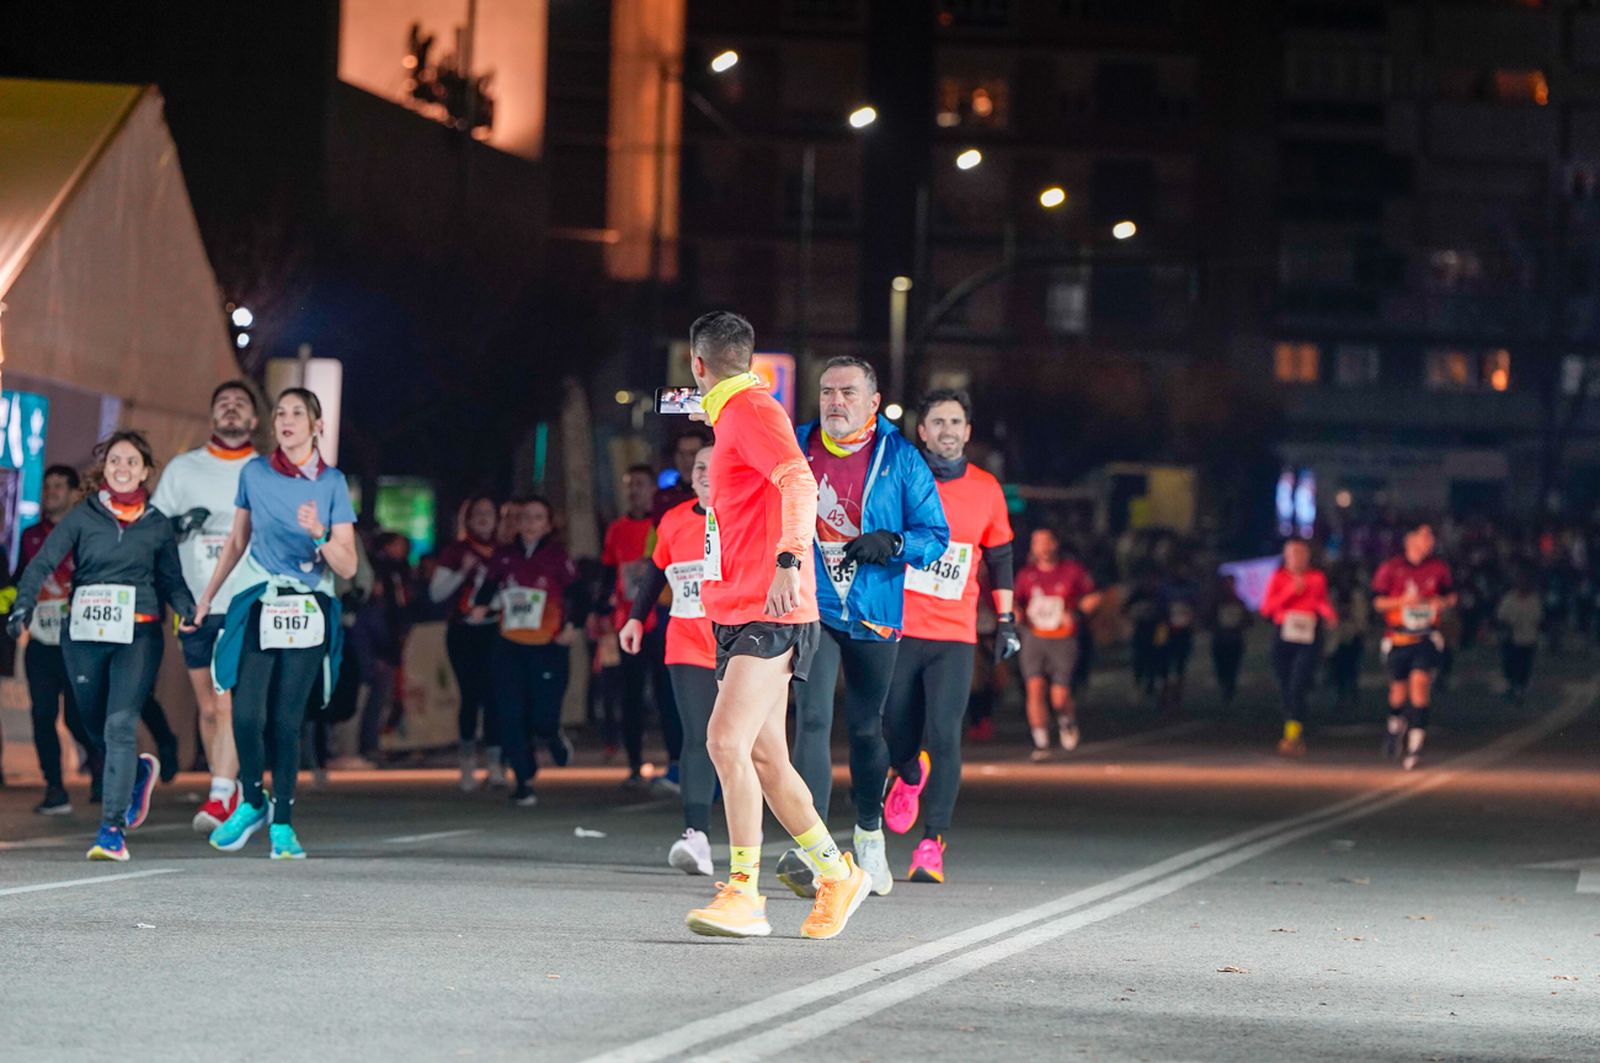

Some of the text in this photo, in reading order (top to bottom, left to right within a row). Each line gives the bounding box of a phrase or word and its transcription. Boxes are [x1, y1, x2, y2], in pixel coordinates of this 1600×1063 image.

[827, 509, 844, 527] 43
[683, 581, 702, 598] 54
[83, 605, 122, 622] 4583
[274, 615, 309, 630] 6167
